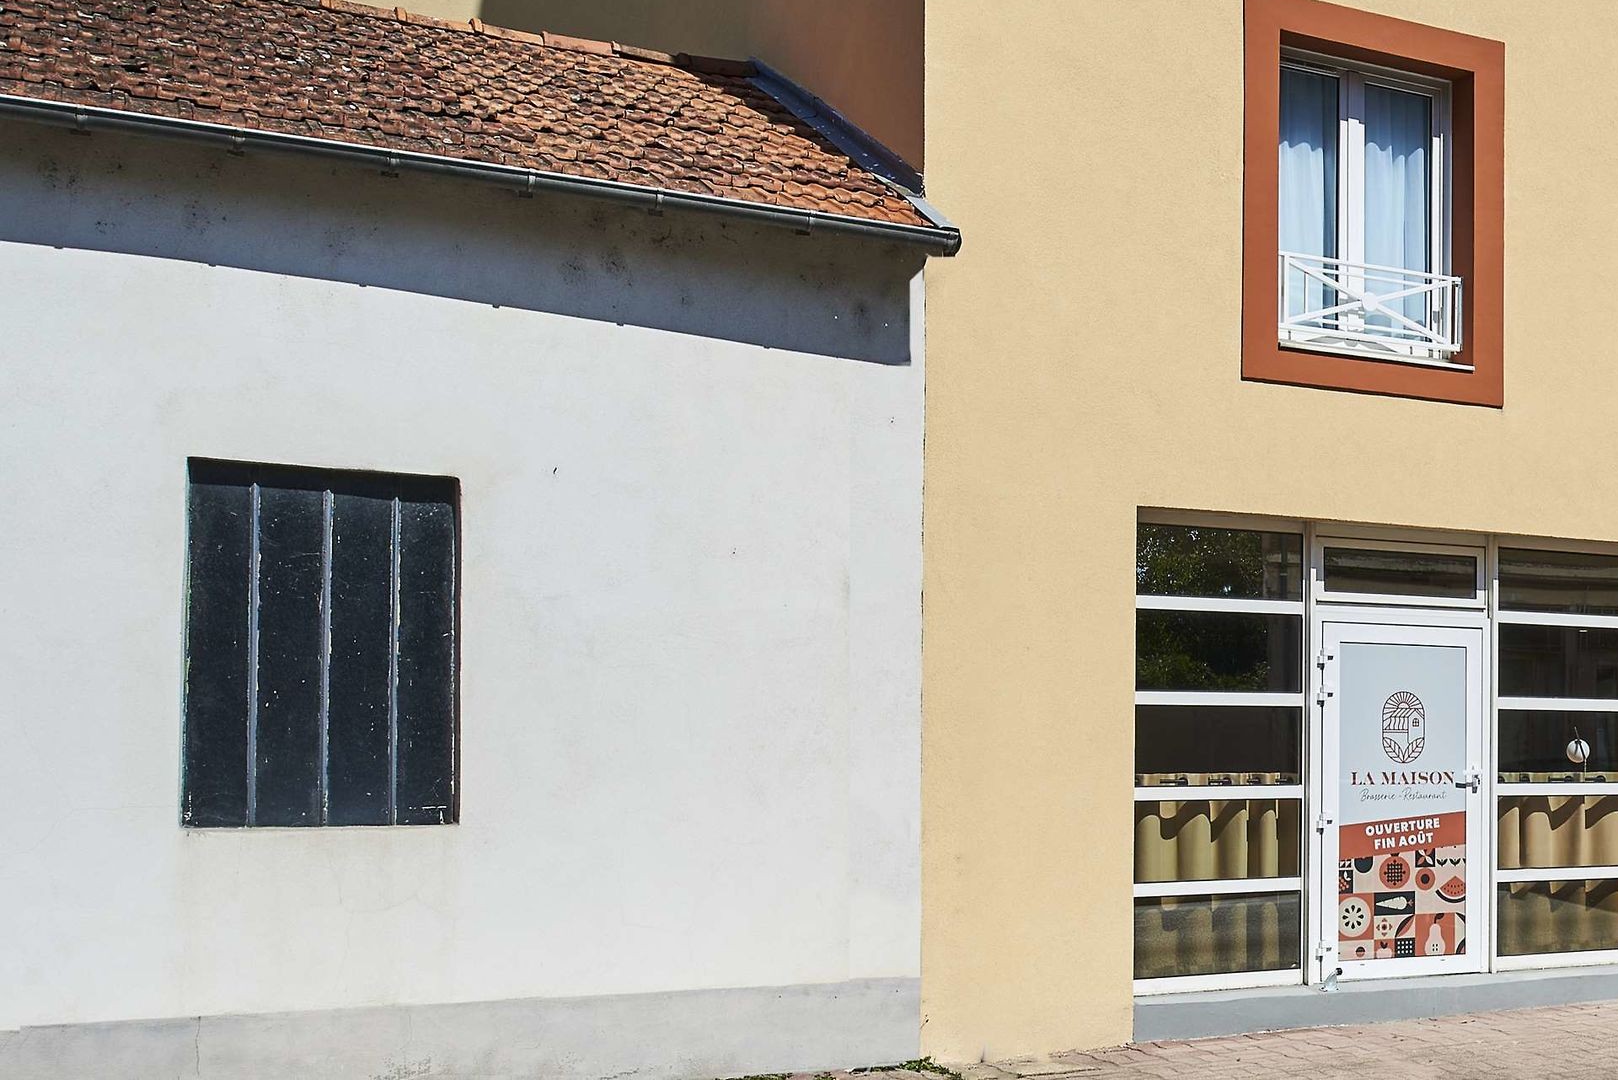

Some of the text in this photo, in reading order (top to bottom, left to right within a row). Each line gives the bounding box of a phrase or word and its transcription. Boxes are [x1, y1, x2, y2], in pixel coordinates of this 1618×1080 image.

[1351, 771, 1455, 786] LA MAISON
[1365, 817, 1441, 837] OUVERTURE
[1374, 830, 1434, 850] FIN AOÛT
